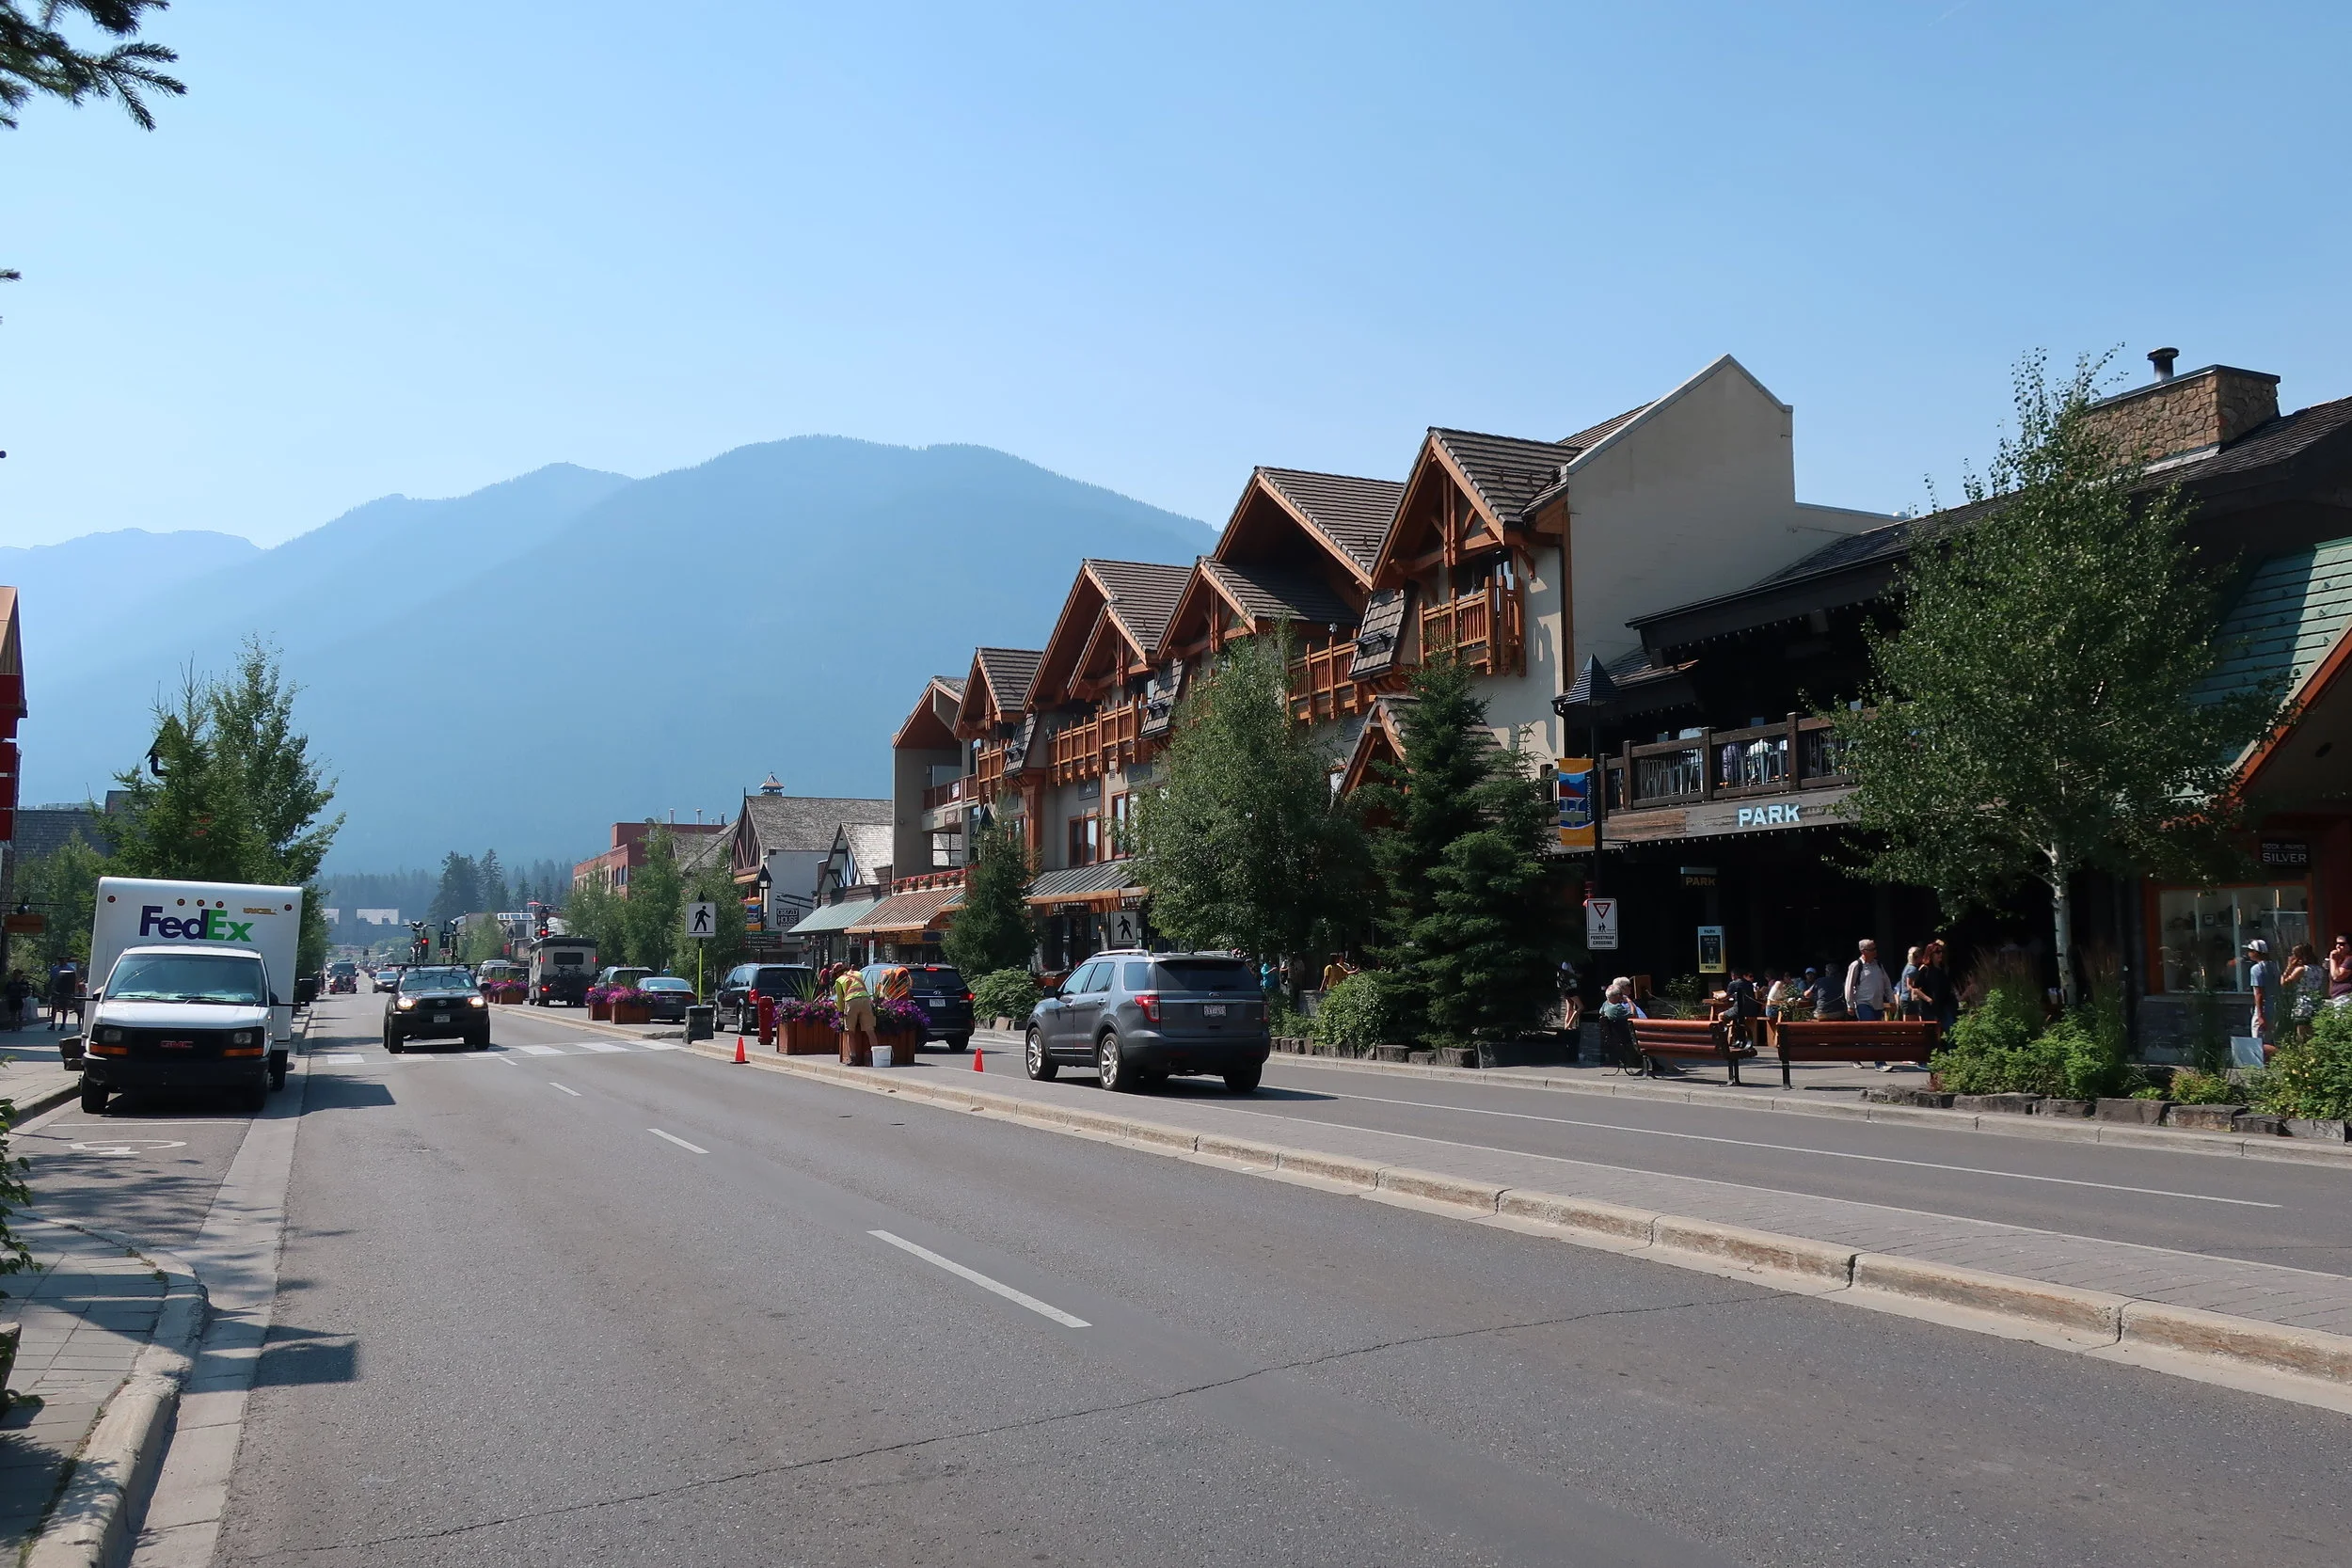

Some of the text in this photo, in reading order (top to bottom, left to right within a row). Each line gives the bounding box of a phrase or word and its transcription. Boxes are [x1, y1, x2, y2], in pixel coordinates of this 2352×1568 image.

[1739, 804, 1801, 828] PARK
[2262, 852, 2308, 863] SILVER
[1685, 877, 1716, 886] PARK
[139, 905, 255, 942] FedEx
[777, 915, 799, 924] HOUSE
